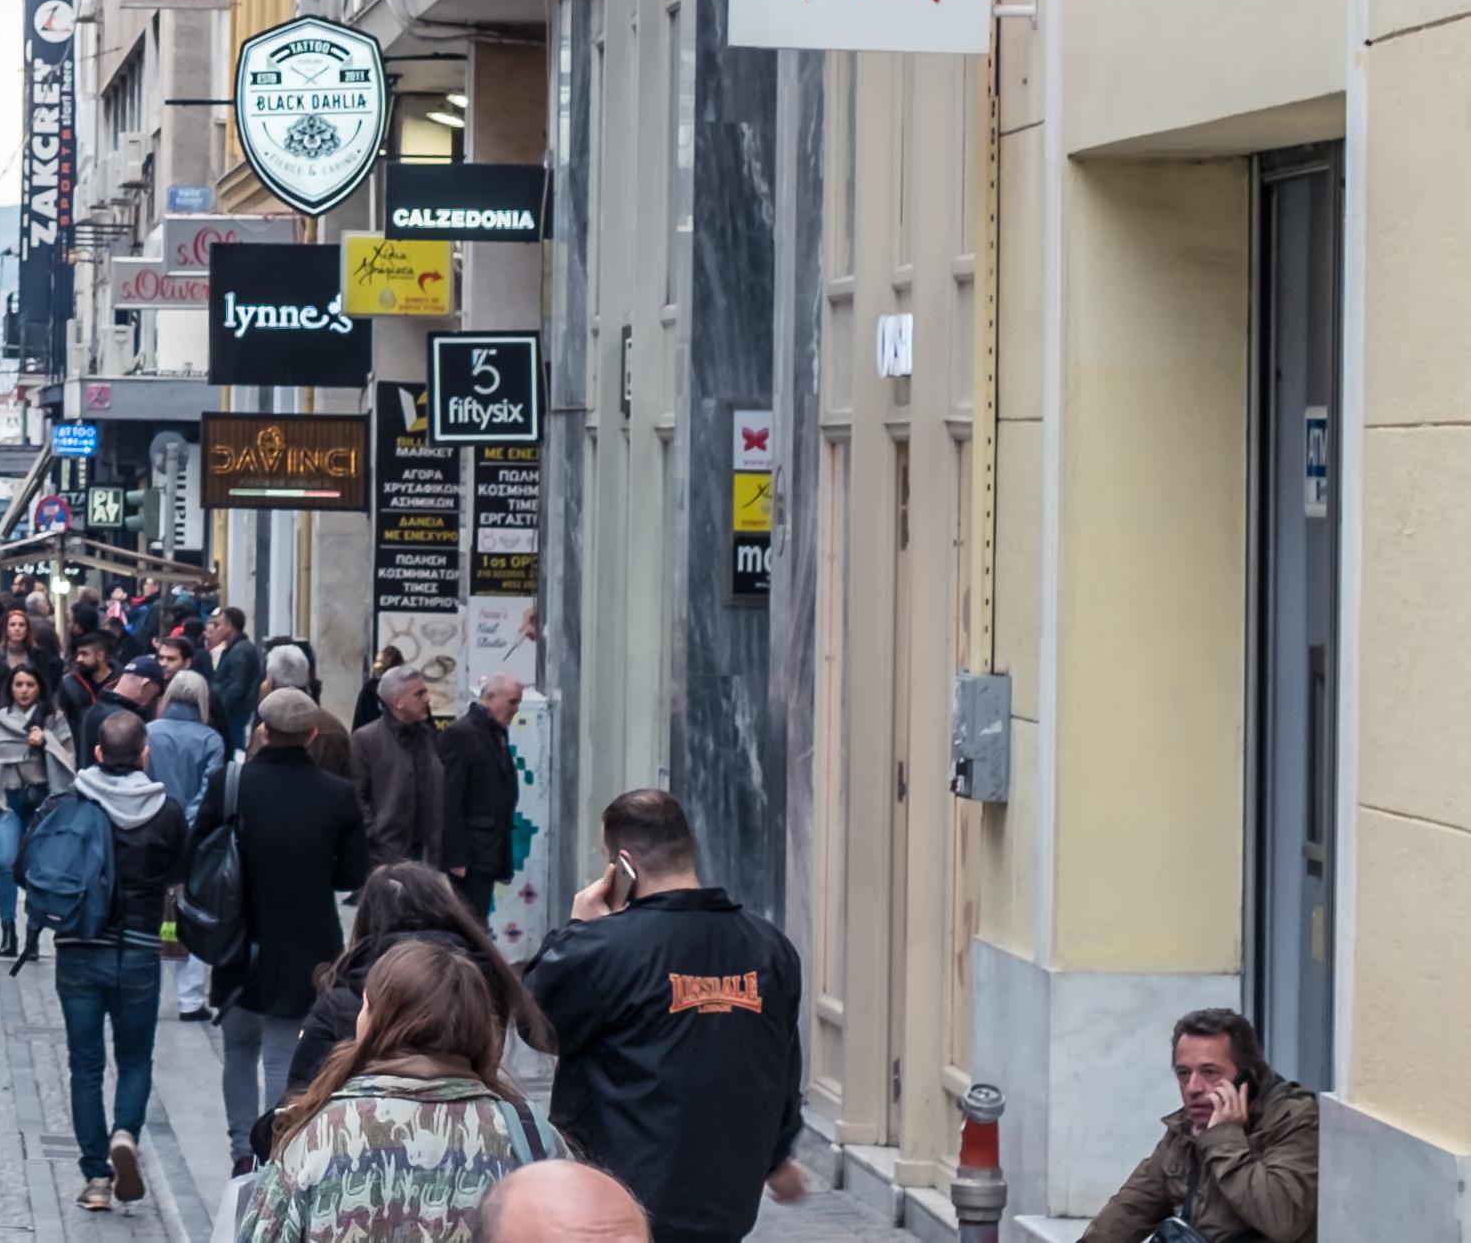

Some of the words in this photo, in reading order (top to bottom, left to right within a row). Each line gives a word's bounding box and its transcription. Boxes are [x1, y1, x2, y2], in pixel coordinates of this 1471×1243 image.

[289, 41, 330, 55] TATTOO
[256, 94, 305, 111] BLACK
[311, 93, 366, 110] DAHLIA
[392, 208, 536, 230] CALZEDONIA
[448, 396, 524, 431] fiftysix
[395, 446, 454, 458] MARKET
[484, 447, 505, 460] ΜΕ
[402, 469, 444, 481] ΑΓΟΡΑ
[390, 496, 455, 508] ΑΣΗΜΙΚΩΝ
[398, 516, 445, 528] ΔΑΝΕΙΑ
[395, 554, 447, 566] ΠΩΛΗΣΗ
[402, 582, 439, 594] ΤΙΜΕΣ
